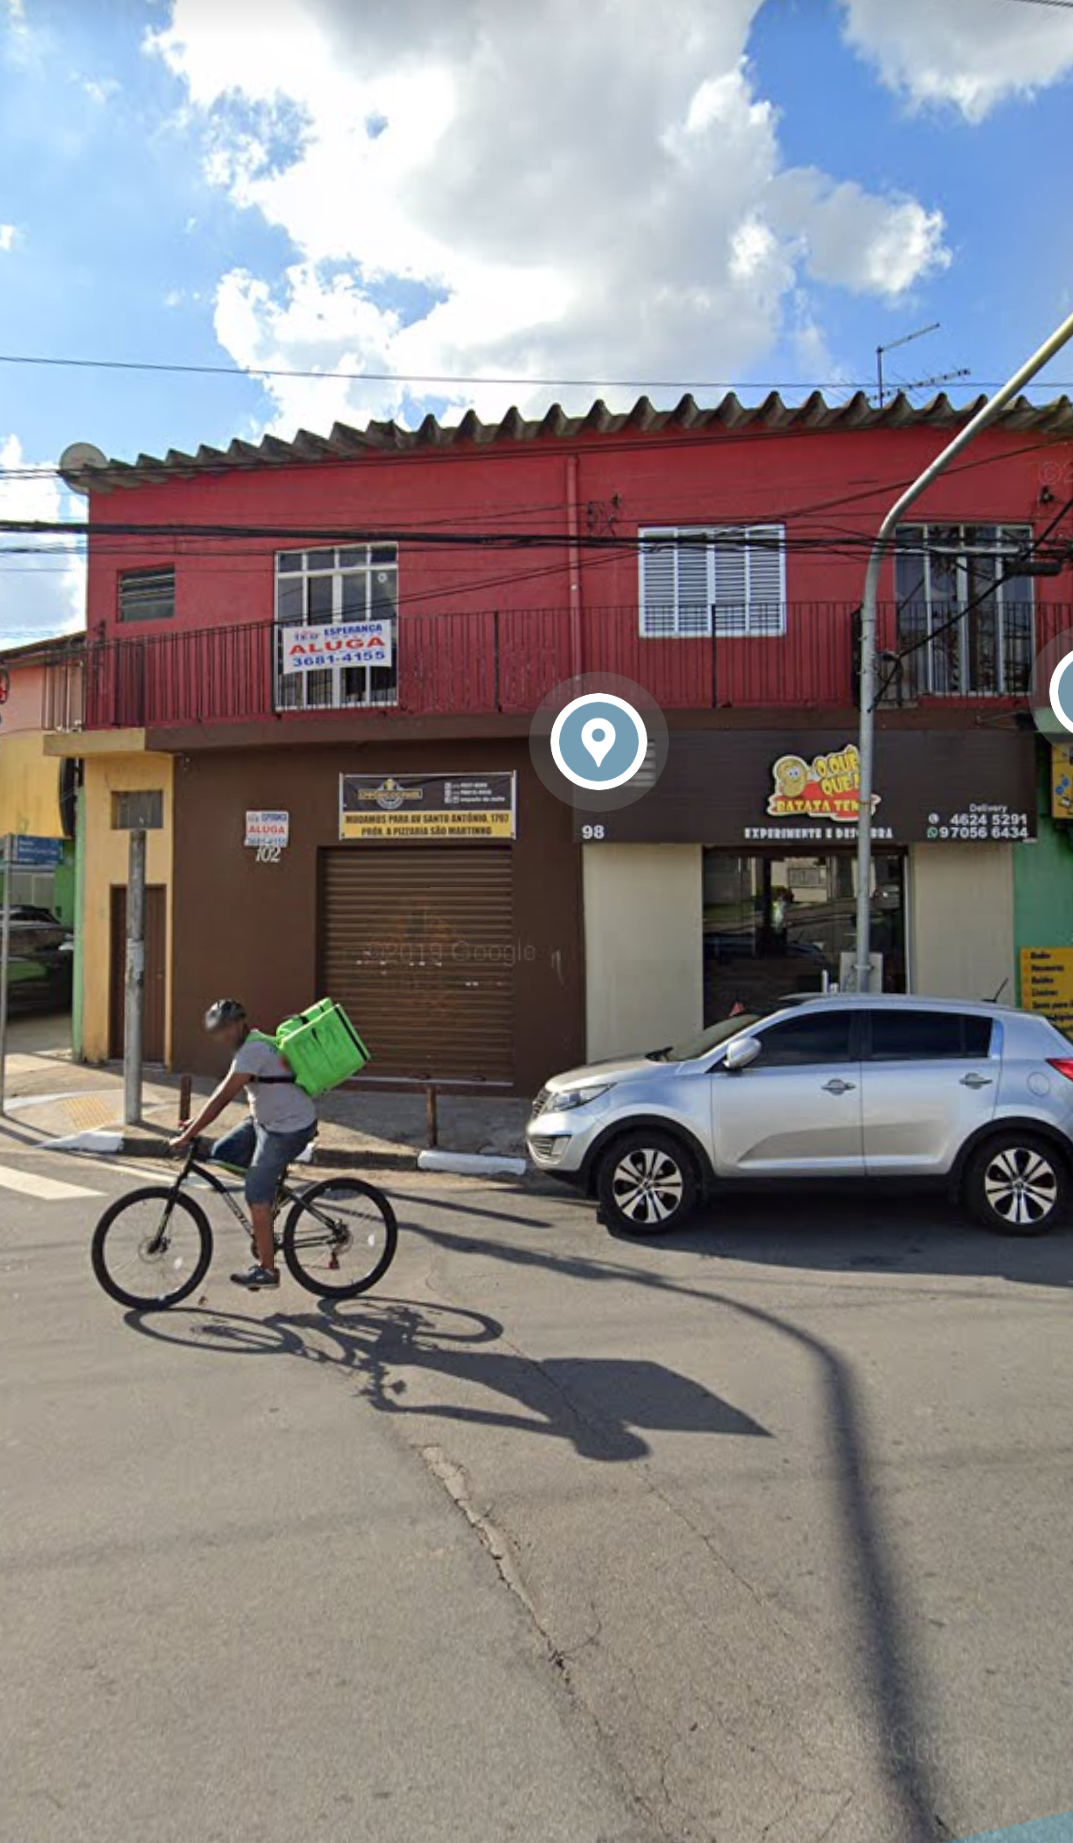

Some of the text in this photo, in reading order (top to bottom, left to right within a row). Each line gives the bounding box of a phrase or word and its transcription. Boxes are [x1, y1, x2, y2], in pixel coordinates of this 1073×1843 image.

[288, 635, 385, 656] ALUGA
[293, 650, 385, 667] 3681-4155
[776, 800, 831, 812] BATATA
[969, 803, 1008, 813] Delivery
[423, 814, 449, 823] SANTO
[949, 813, 1028, 826] 4624 5291
[247, 825, 285, 833] ALUGA
[581, 824, 605, 840] 98
[939, 826, 1029, 838] 97056 6434
[255, 845, 282, 862] 102
